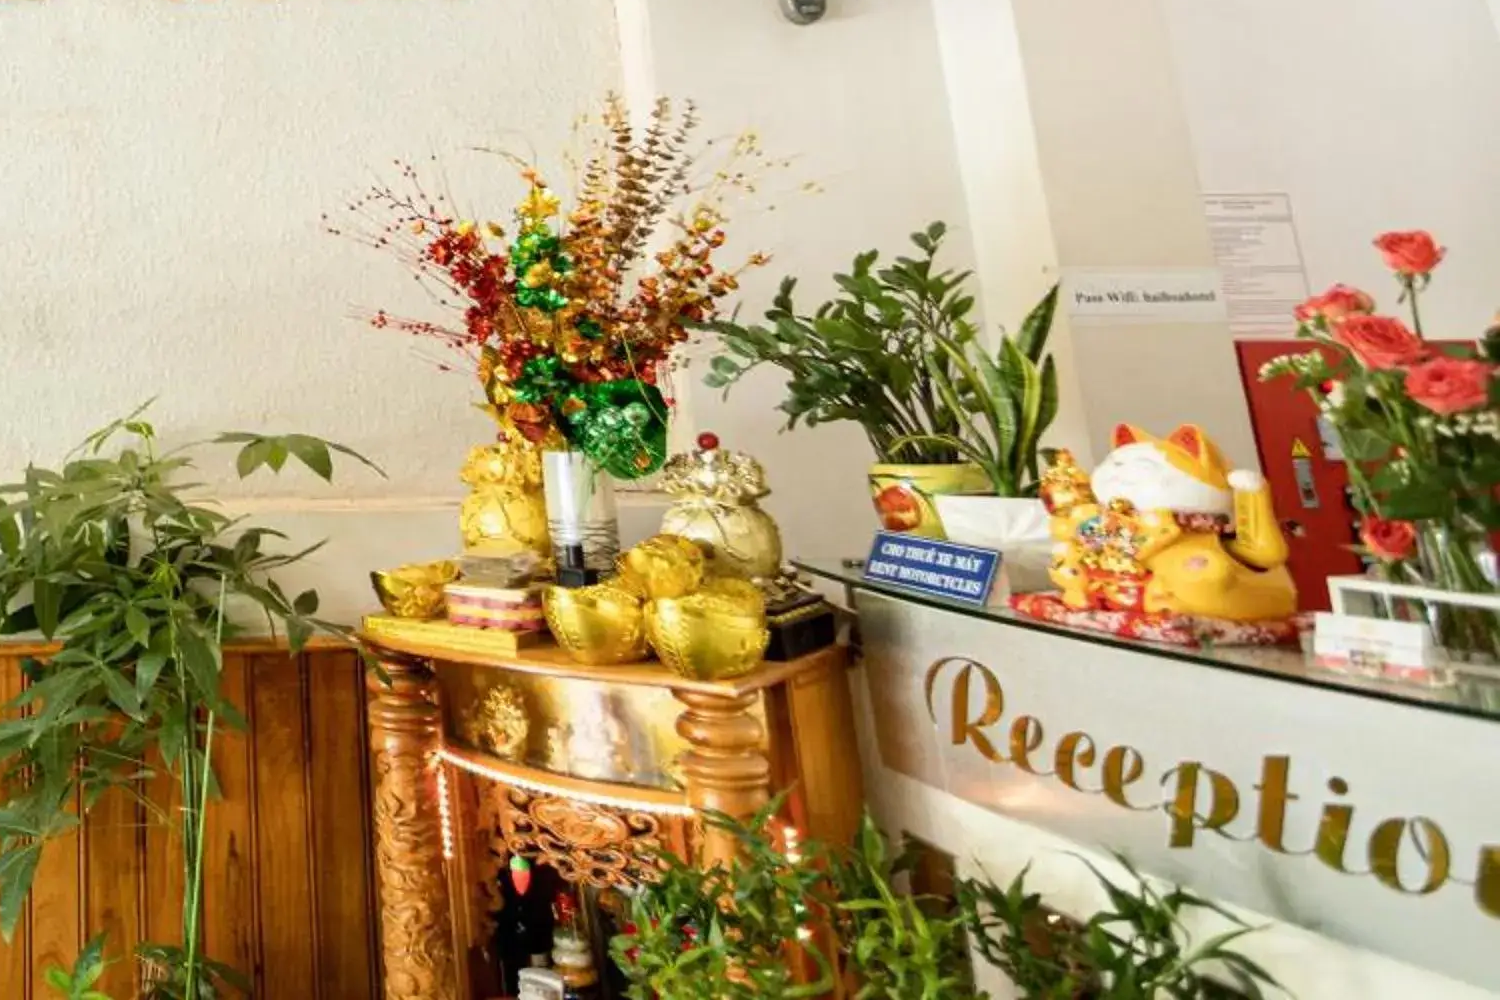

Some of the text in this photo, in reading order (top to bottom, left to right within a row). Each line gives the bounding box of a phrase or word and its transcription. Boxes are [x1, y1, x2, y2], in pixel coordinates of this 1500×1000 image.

[868, 560, 982, 595] RENT MOTORCYCLES
[925, 656, 1500, 919] Receptio
